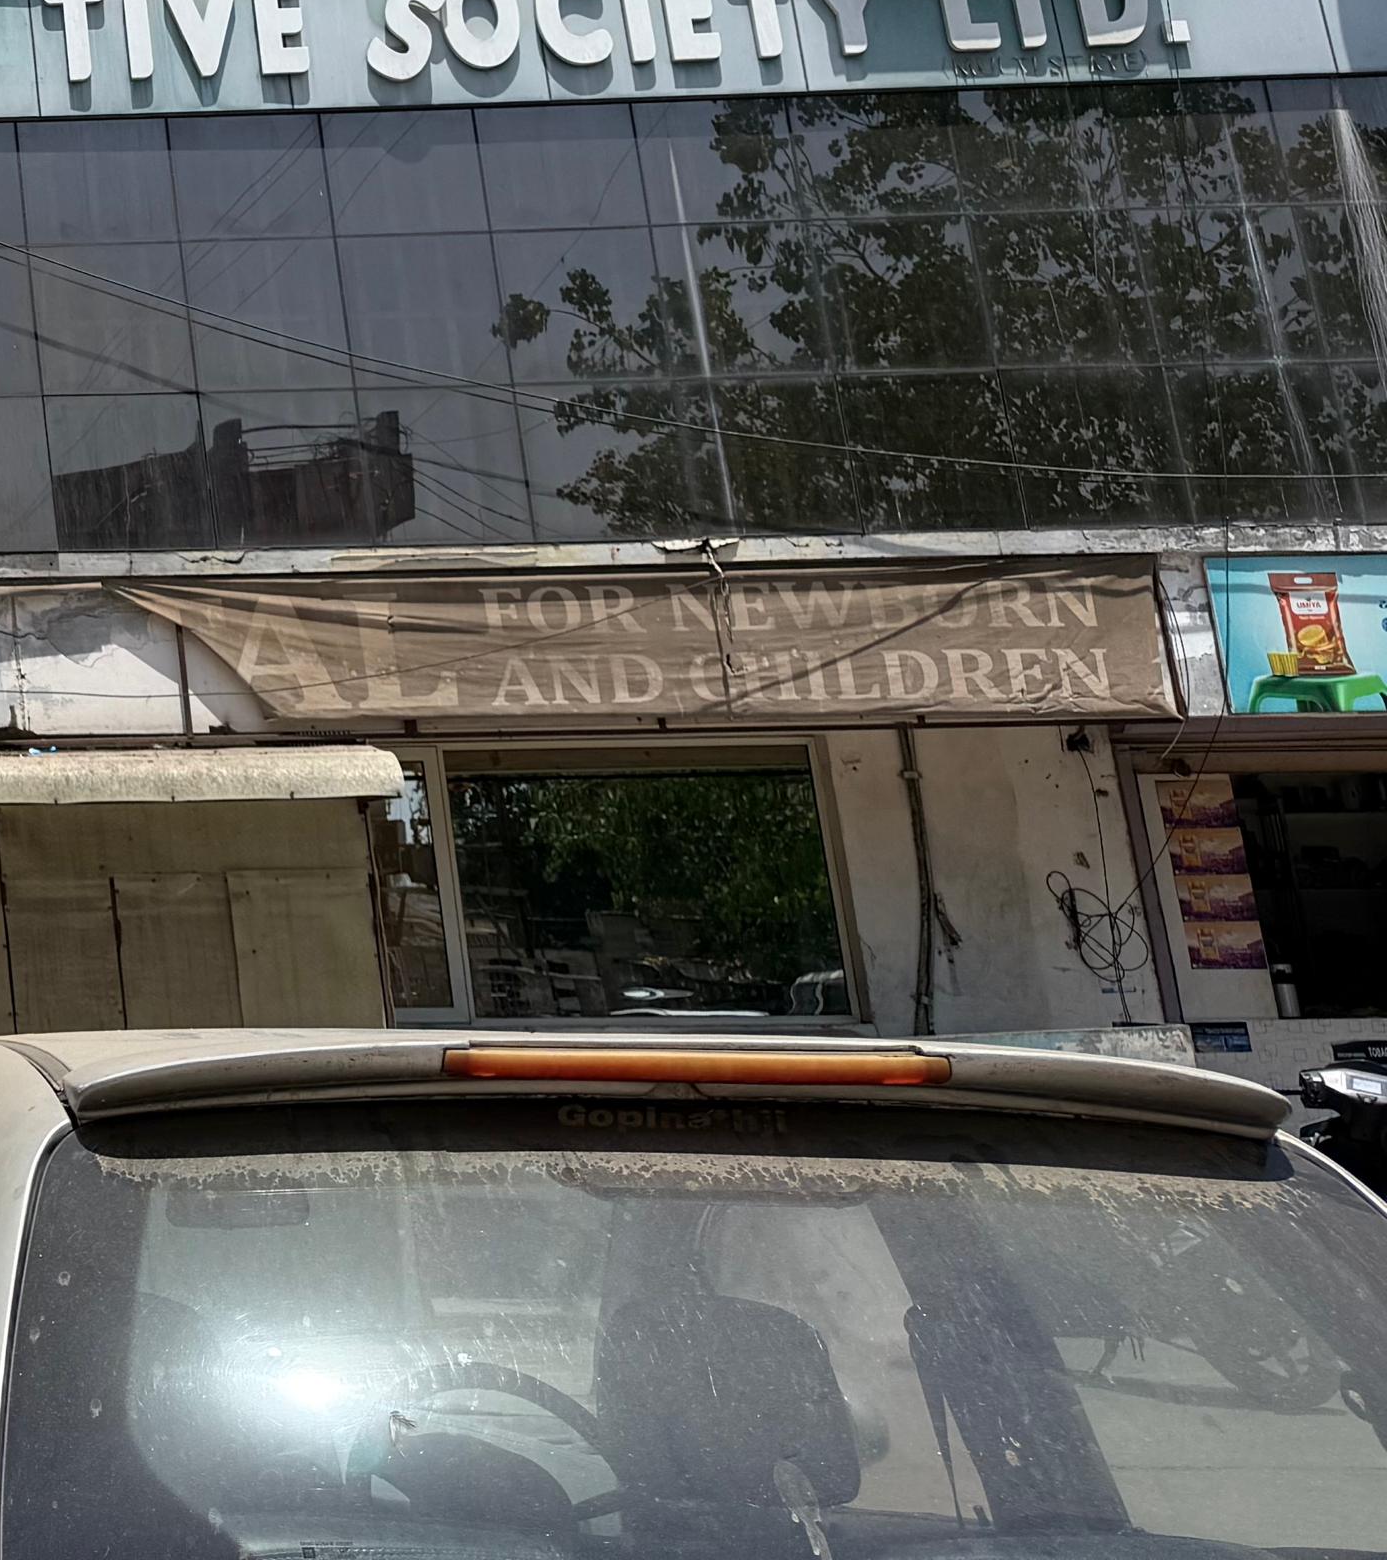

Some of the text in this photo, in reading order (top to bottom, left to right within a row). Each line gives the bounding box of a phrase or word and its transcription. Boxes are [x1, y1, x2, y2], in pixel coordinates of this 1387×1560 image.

[479, 576, 1100, 636] FOR NEWBORN
[493, 646, 1110, 709] AND CHILDREN
